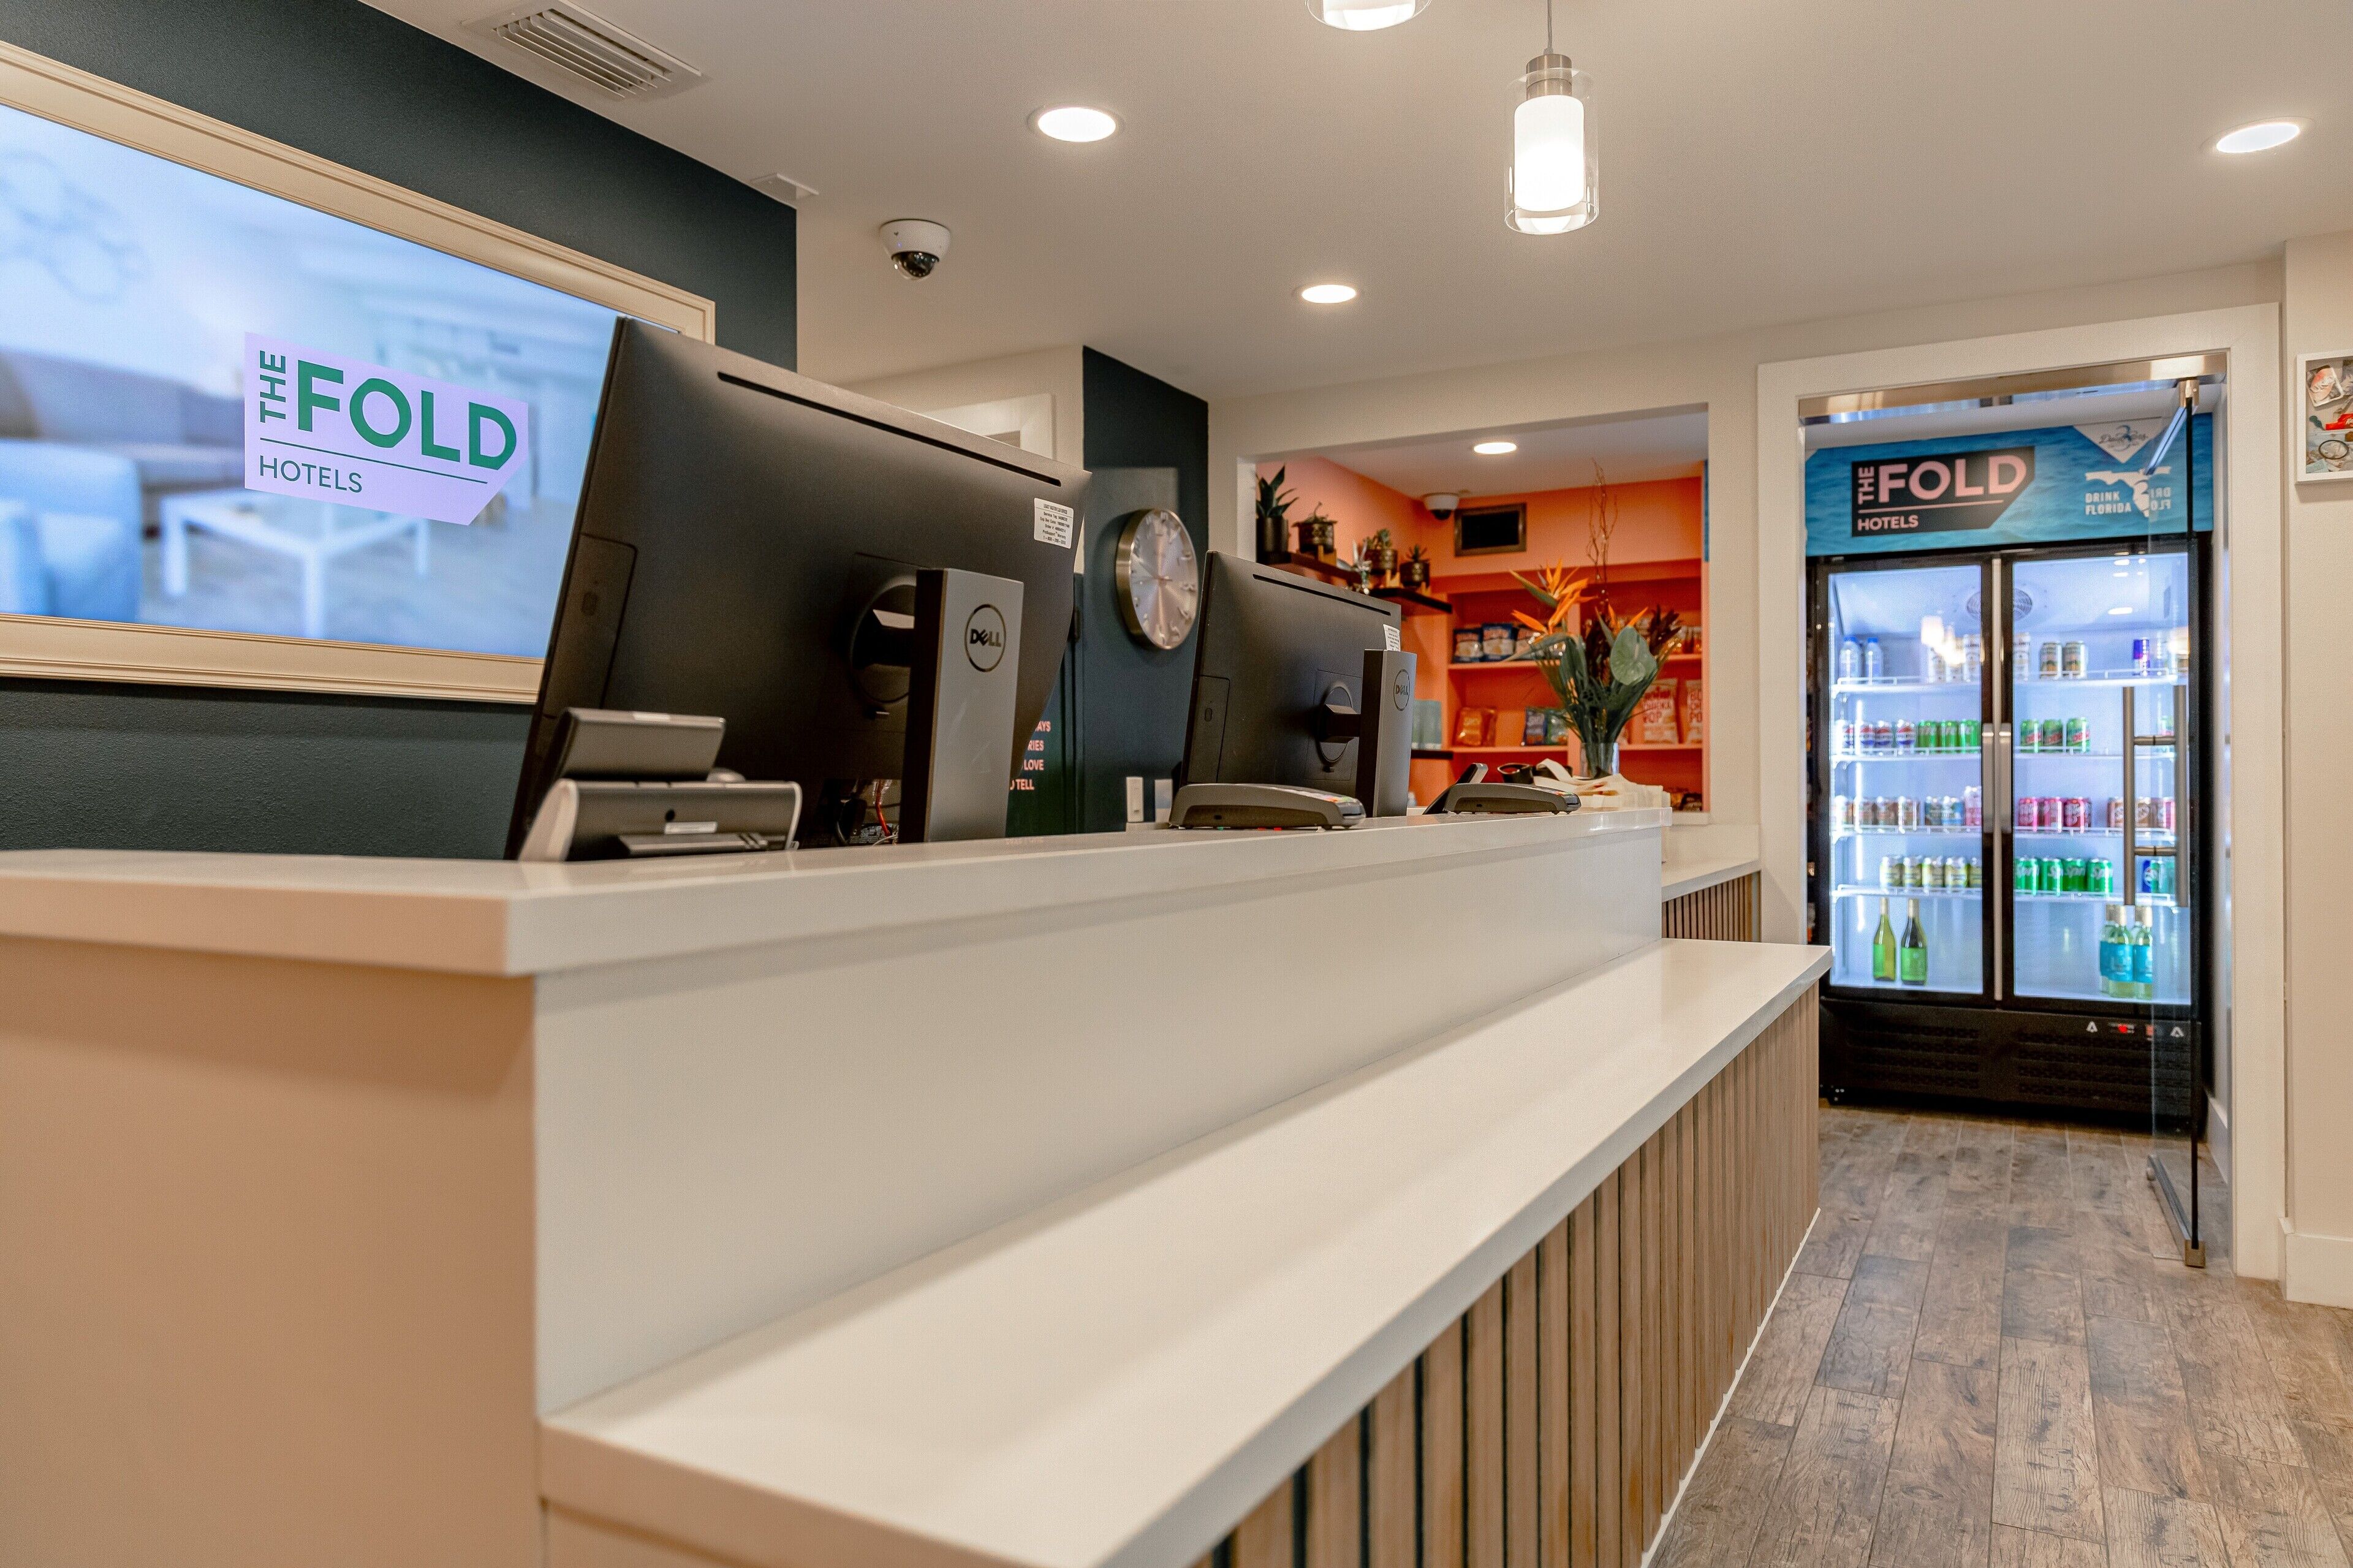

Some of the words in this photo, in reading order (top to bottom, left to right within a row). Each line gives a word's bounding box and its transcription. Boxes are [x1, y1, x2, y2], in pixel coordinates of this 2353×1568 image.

[260, 350, 286, 423] THE
[298, 359, 517, 470] FOLD
[260, 455, 362, 493] HOTELS
[1878, 455, 2027, 503] FOLD
[1857, 466, 1874, 505] THE
[2085, 491, 2120, 503] DRINK
[2085, 502, 2132, 515] FLORIDA
[1857, 515, 1919, 531] HOTELS
[970, 629, 1001, 647] DELL
[1395, 684, 1409, 696] DELL
[1035, 721, 1051, 732] AYS
[1028, 740, 1044, 751] RIES
[1024, 759, 1044, 771] LOVE
[1015, 778, 1035, 790] TELL
